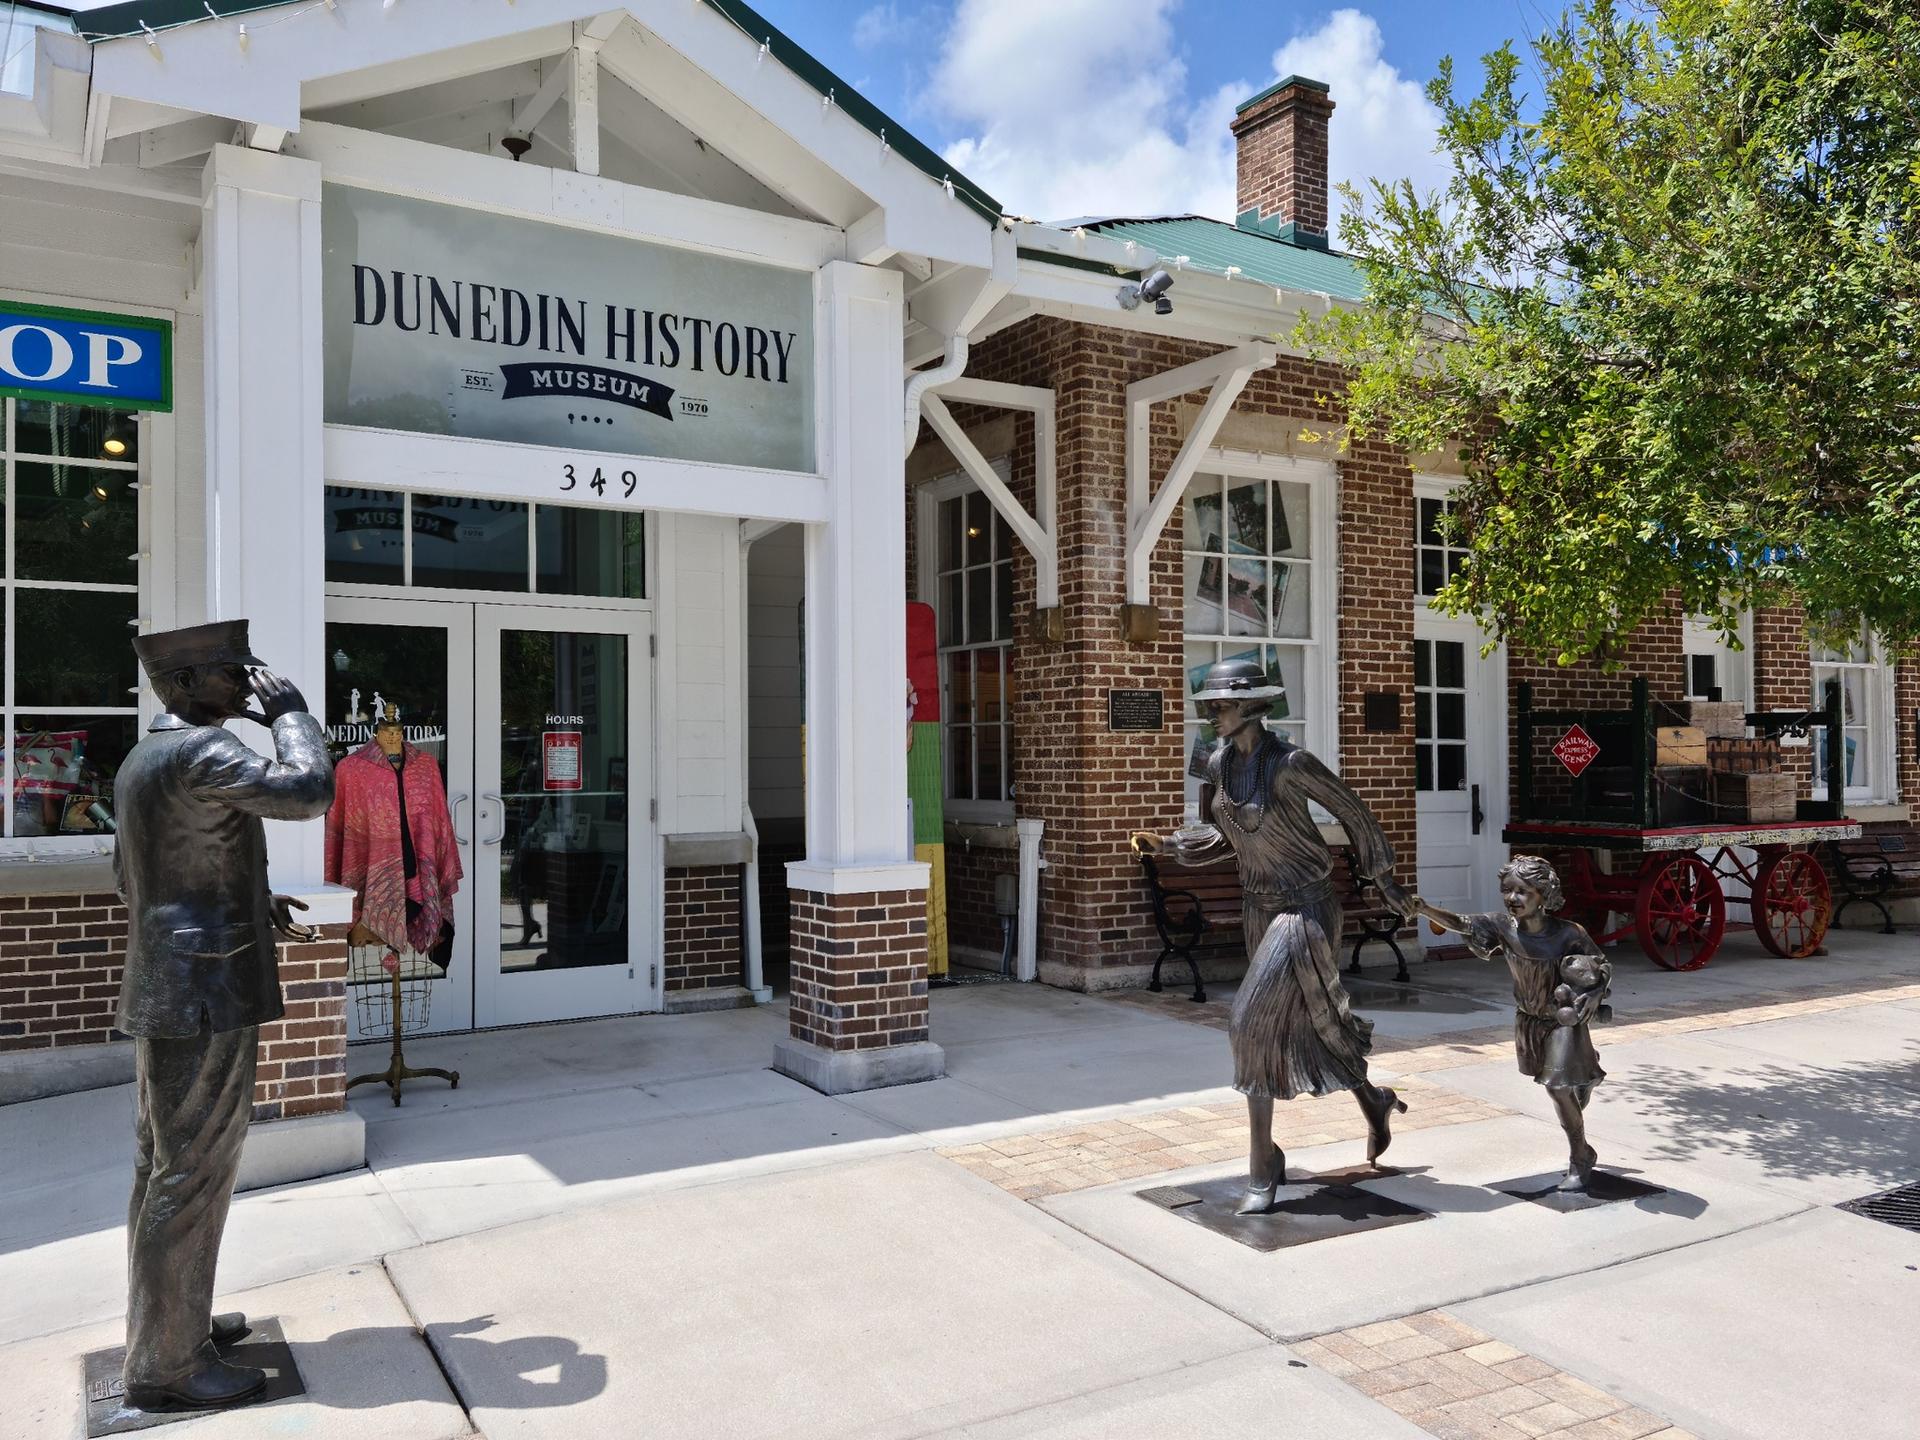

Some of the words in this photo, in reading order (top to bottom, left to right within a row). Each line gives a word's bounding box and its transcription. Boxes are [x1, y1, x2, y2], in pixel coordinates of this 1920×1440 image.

[352, 264, 587, 356] DUNEDIN
[605, 304, 796, 384] HISTORY
[0, 324, 143, 388] OP
[465, 374, 492, 388] EST.
[530, 369, 650, 403] MUSEUM
[680, 401, 709, 414] 1970
[559, 464, 637, 498] 349
[355, 511, 441, 532] MUSUM
[546, 715, 584, 725] HOURS
[327, 724, 374, 742] NEDIN
[403, 724, 443, 742] TORY
[1559, 737, 1594, 750] RAILWAY
[1559, 751, 1592, 764] AGENCY
